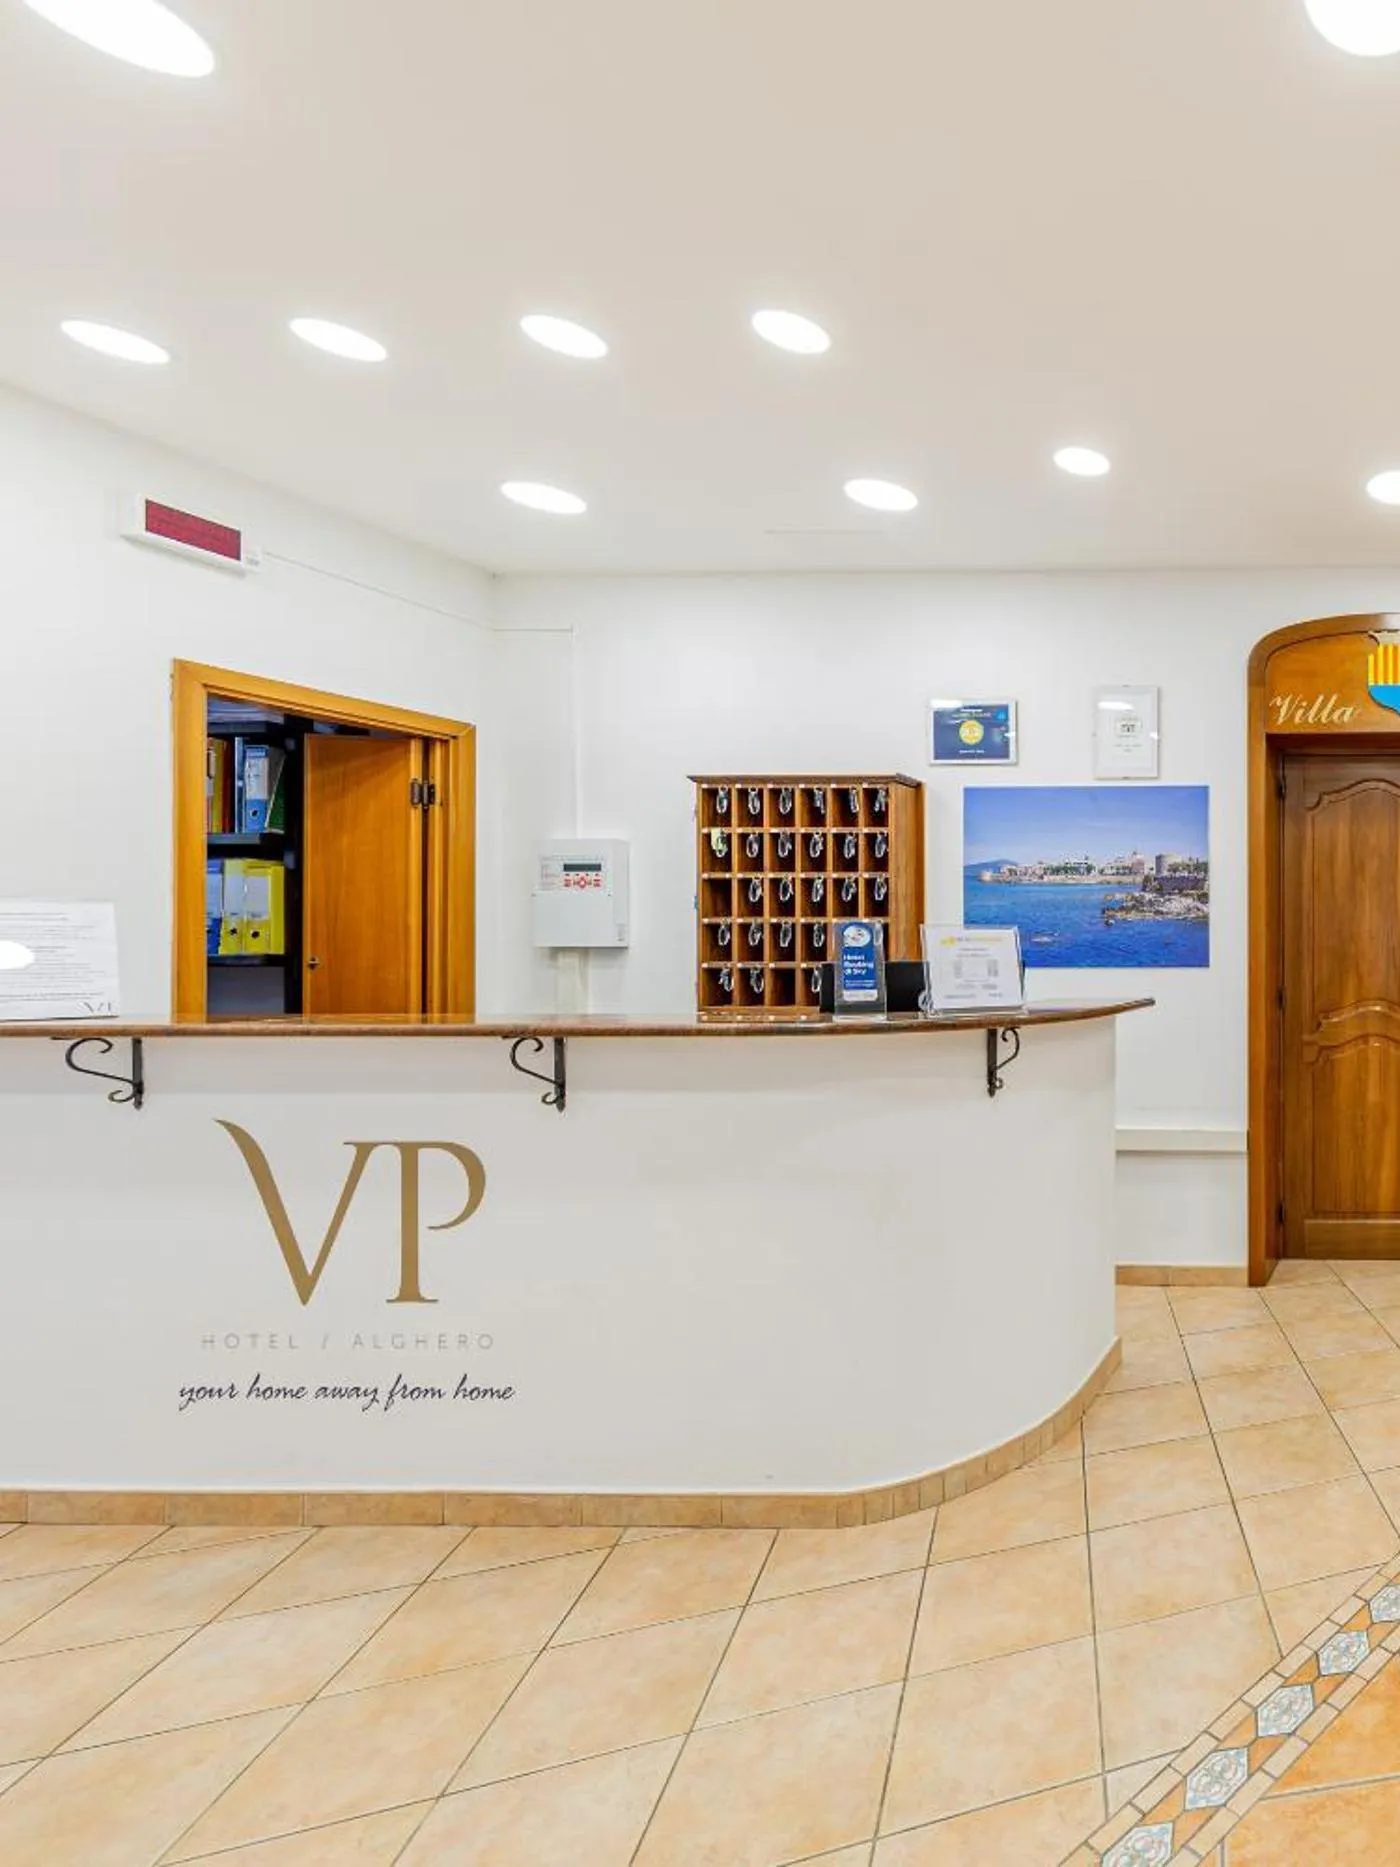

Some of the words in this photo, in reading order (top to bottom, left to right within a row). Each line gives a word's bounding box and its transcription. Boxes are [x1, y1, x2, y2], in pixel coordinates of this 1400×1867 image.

[1269, 693, 1357, 725] Villa
[212, 1117, 487, 1306] VP
[201, 1333, 299, 1350] HOTEL
[352, 1333, 494, 1350] ALGHERO
[178, 1383, 239, 1411] your
[246, 1373, 307, 1400] home
[315, 1386, 379, 1412] away
[384, 1373, 446, 1412] from
[453, 1373, 516, 1400] home
